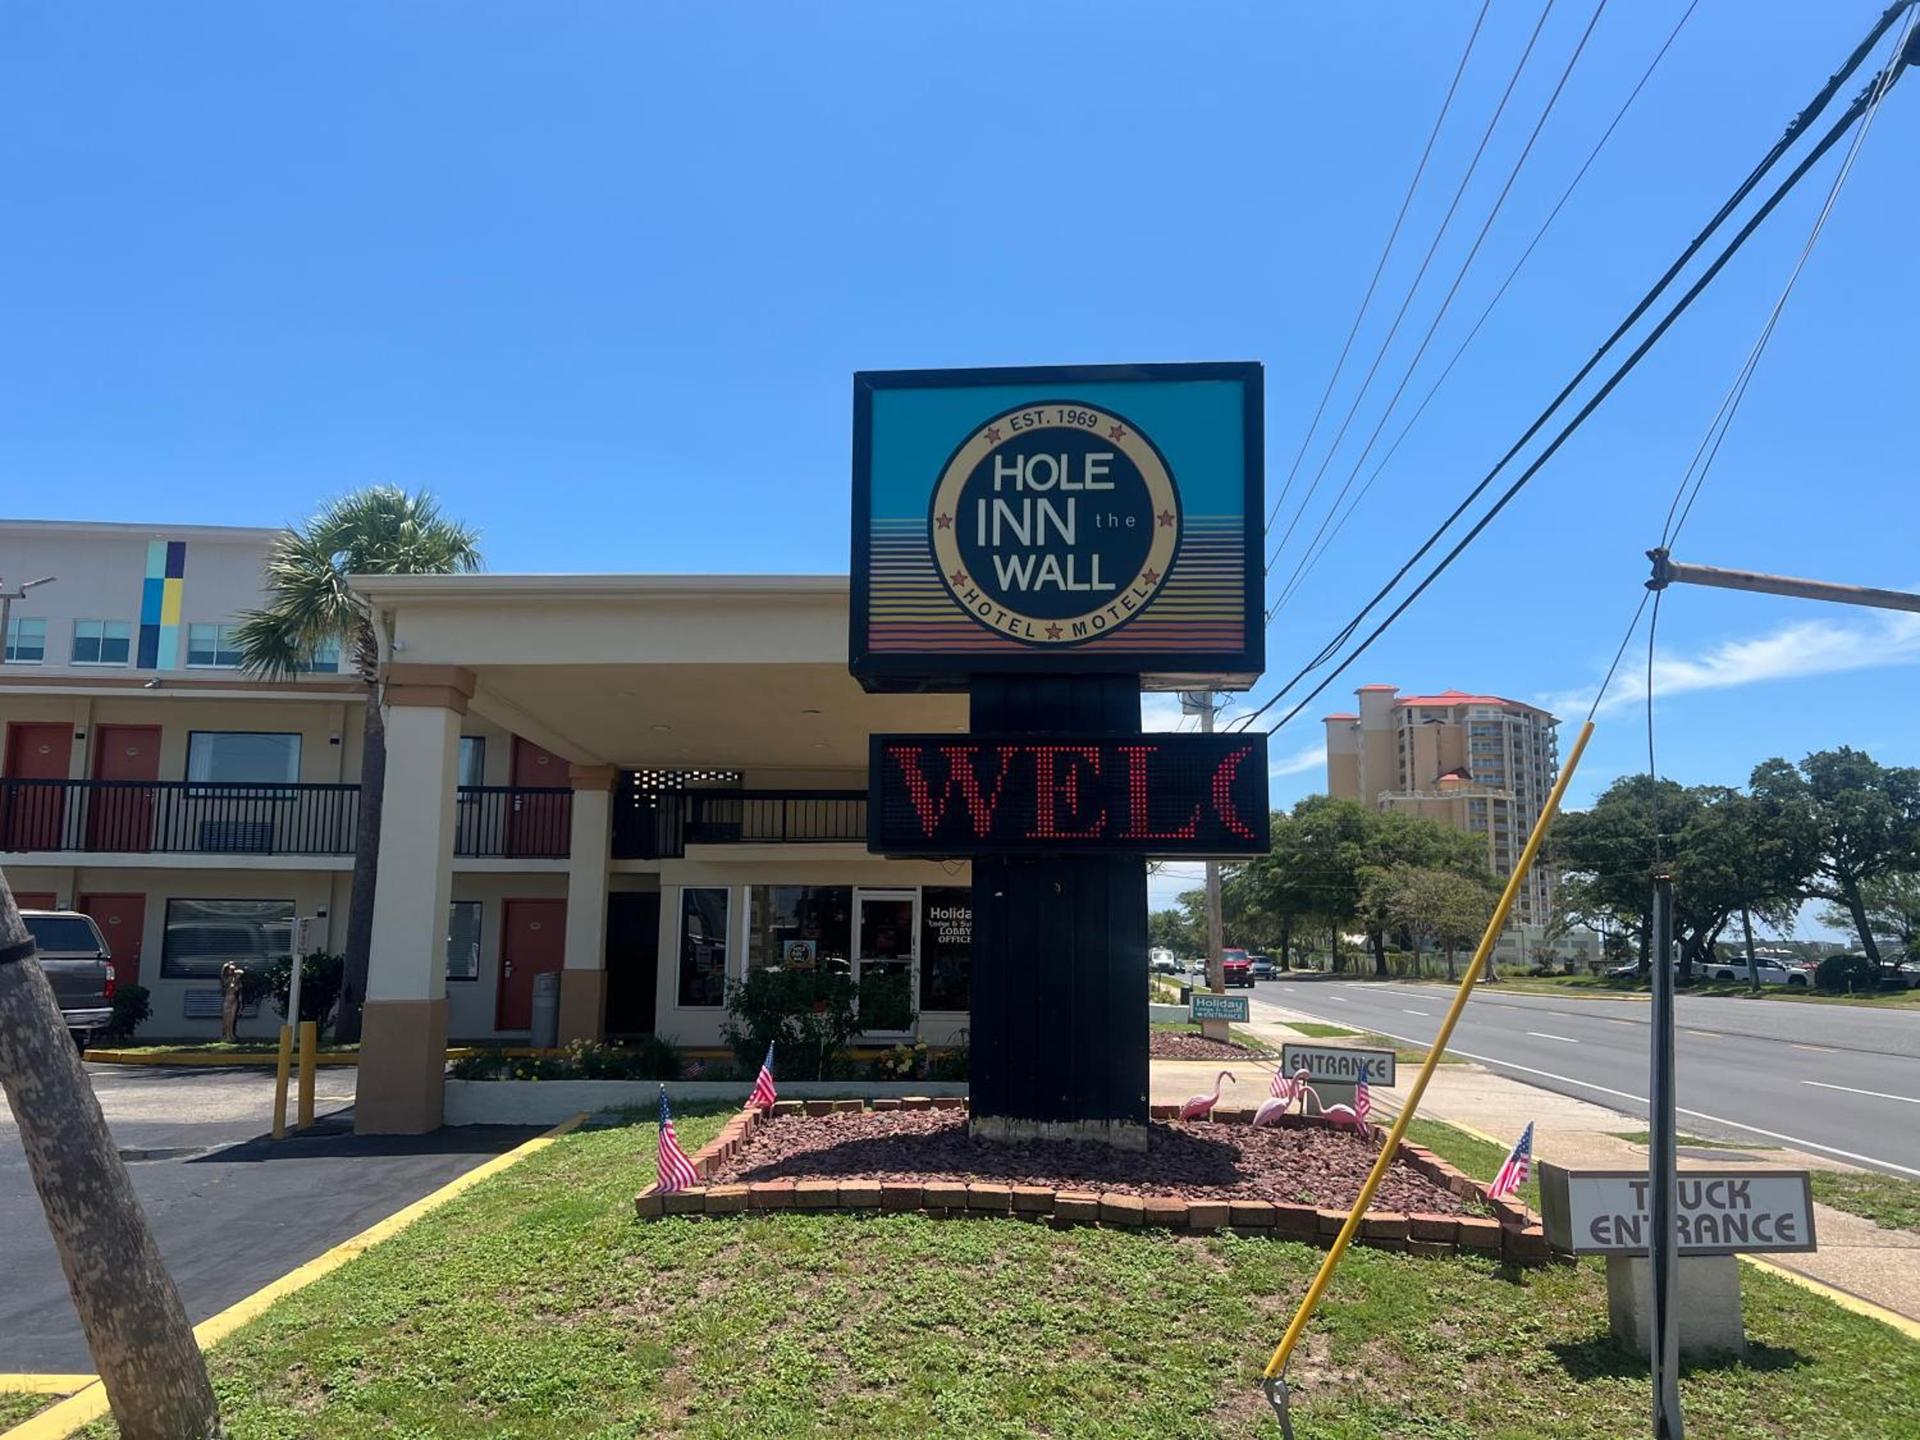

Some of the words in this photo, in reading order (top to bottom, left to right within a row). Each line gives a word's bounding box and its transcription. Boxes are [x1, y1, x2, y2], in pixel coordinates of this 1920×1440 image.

[1010, 410, 1050, 432] EST.
[1057, 408, 1098, 430] 1969
[994, 453, 1115, 492] HOLE
[977, 498, 1076, 547] INN
[1096, 512, 1136, 529] the
[993, 553, 1116, 592] WALL
[962, 588, 1036, 638] HOTEL
[1073, 586, 1149, 638] MOTEL
[930, 906, 972, 919] Holida
[940, 927, 972, 935] LOBBY
[1196, 997, 1244, 1010] Holiday
[1290, 1053, 1386, 1078] ENTRANCE
[1629, 1180, 1752, 1210] TUCK
[1590, 1212, 1796, 1244] ENRANCE
